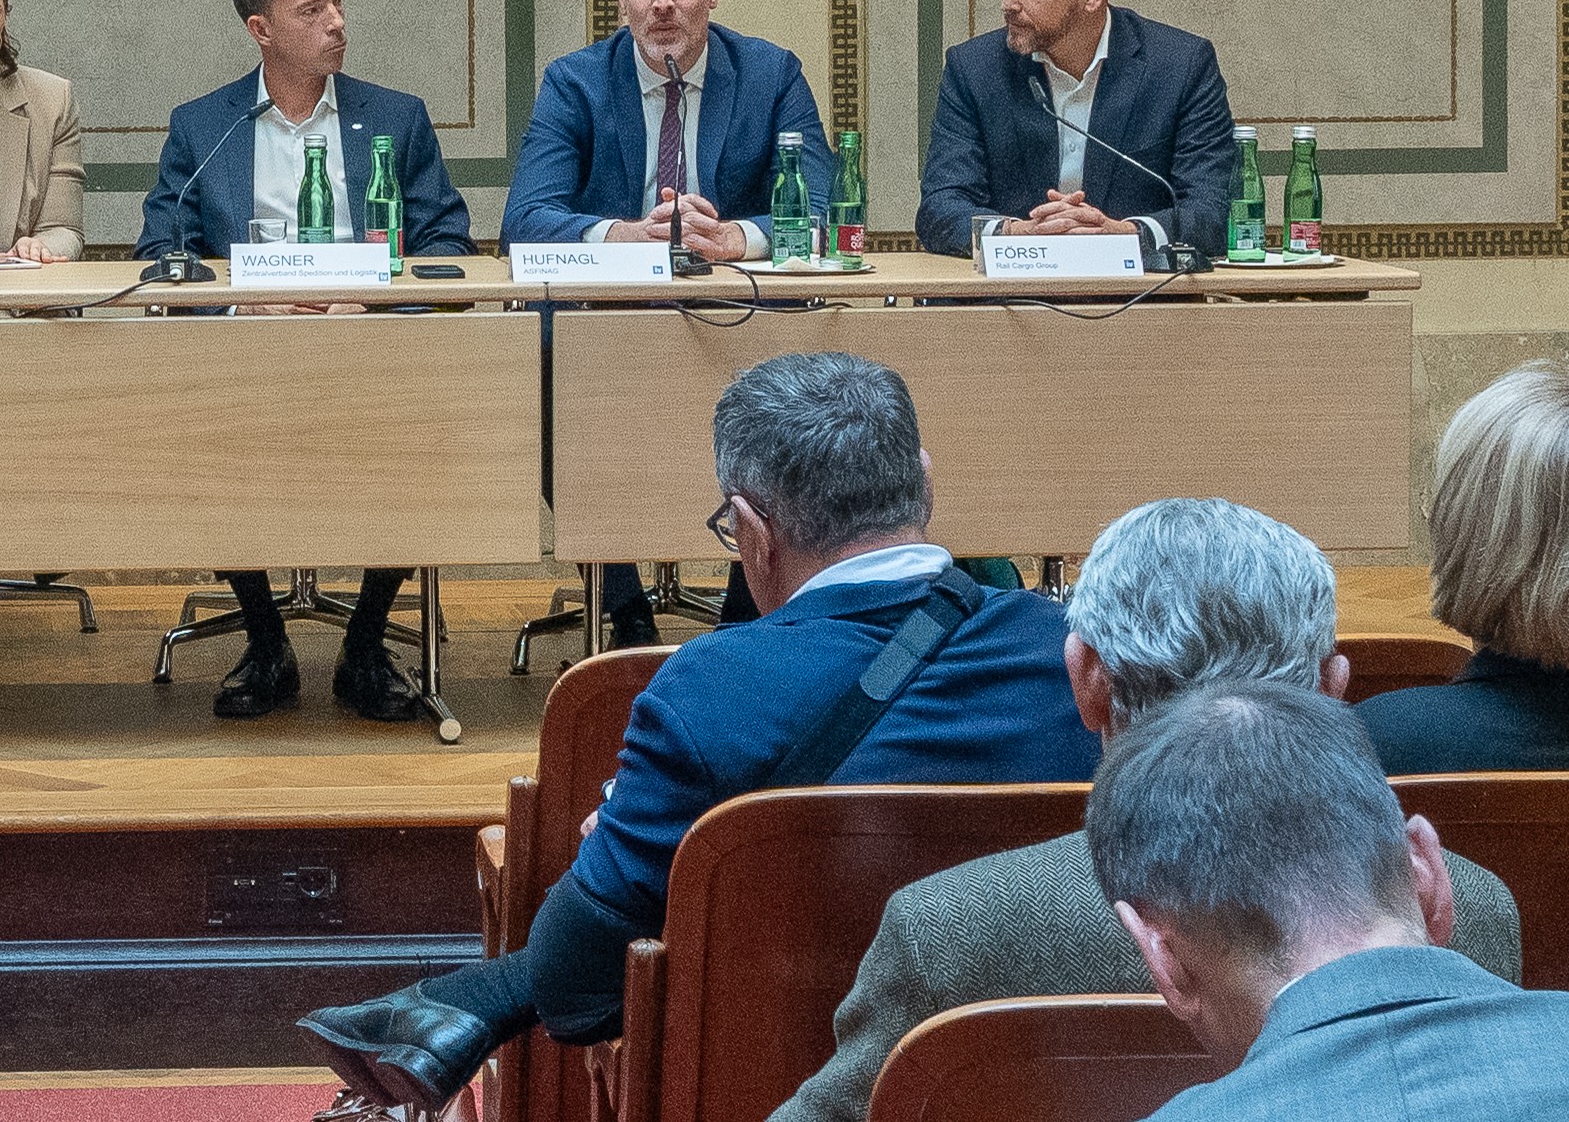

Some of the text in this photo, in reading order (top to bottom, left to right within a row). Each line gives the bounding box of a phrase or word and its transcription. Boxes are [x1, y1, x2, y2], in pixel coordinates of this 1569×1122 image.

[994, 245, 1048, 259] FÖRST
[241, 254, 315, 267] WAGNER
[522, 253, 599, 266] HUFNAGL
[334, 269, 349, 277] und
[1012, 262, 1033, 271] Cargo
[1036, 262, 1059, 271] Group
